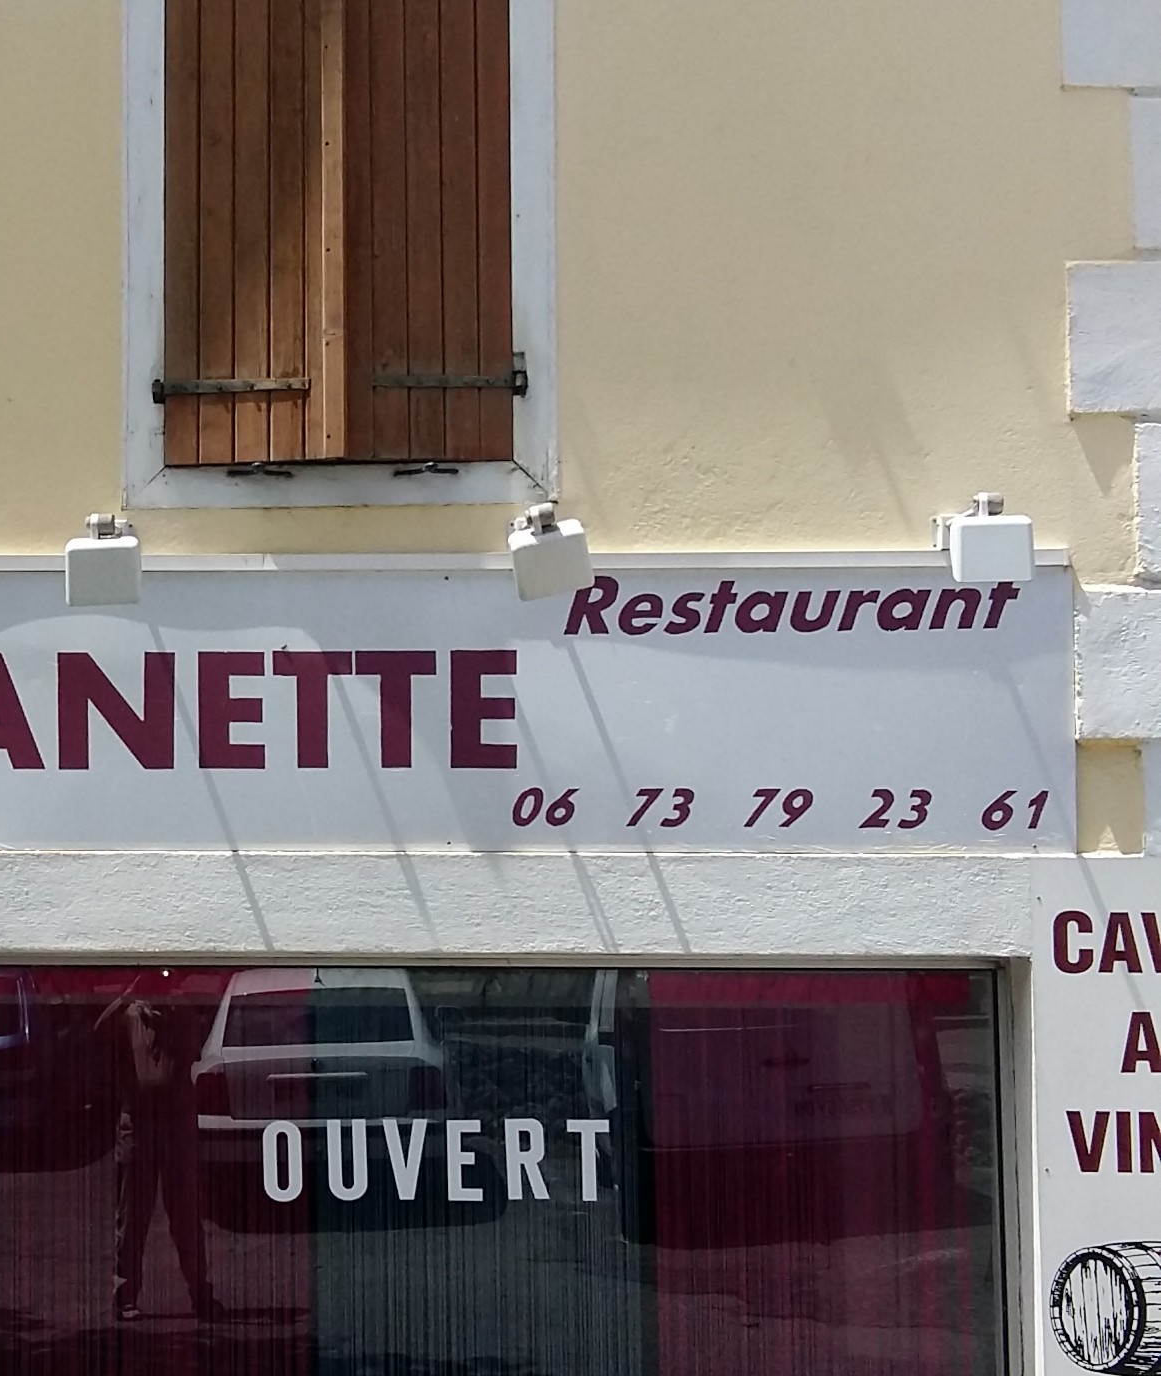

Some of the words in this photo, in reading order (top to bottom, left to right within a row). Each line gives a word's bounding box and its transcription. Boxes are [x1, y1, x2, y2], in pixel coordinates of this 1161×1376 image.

[564, 575, 1020, 636] Restaurant
[512, 787, 580, 827] 06
[625, 787, 695, 828] 73
[743, 788, 814, 828] 79
[858, 788, 932, 830] 23
[981, 790, 1049, 831] 61
[262, 1118, 610, 1203] OUVERT
